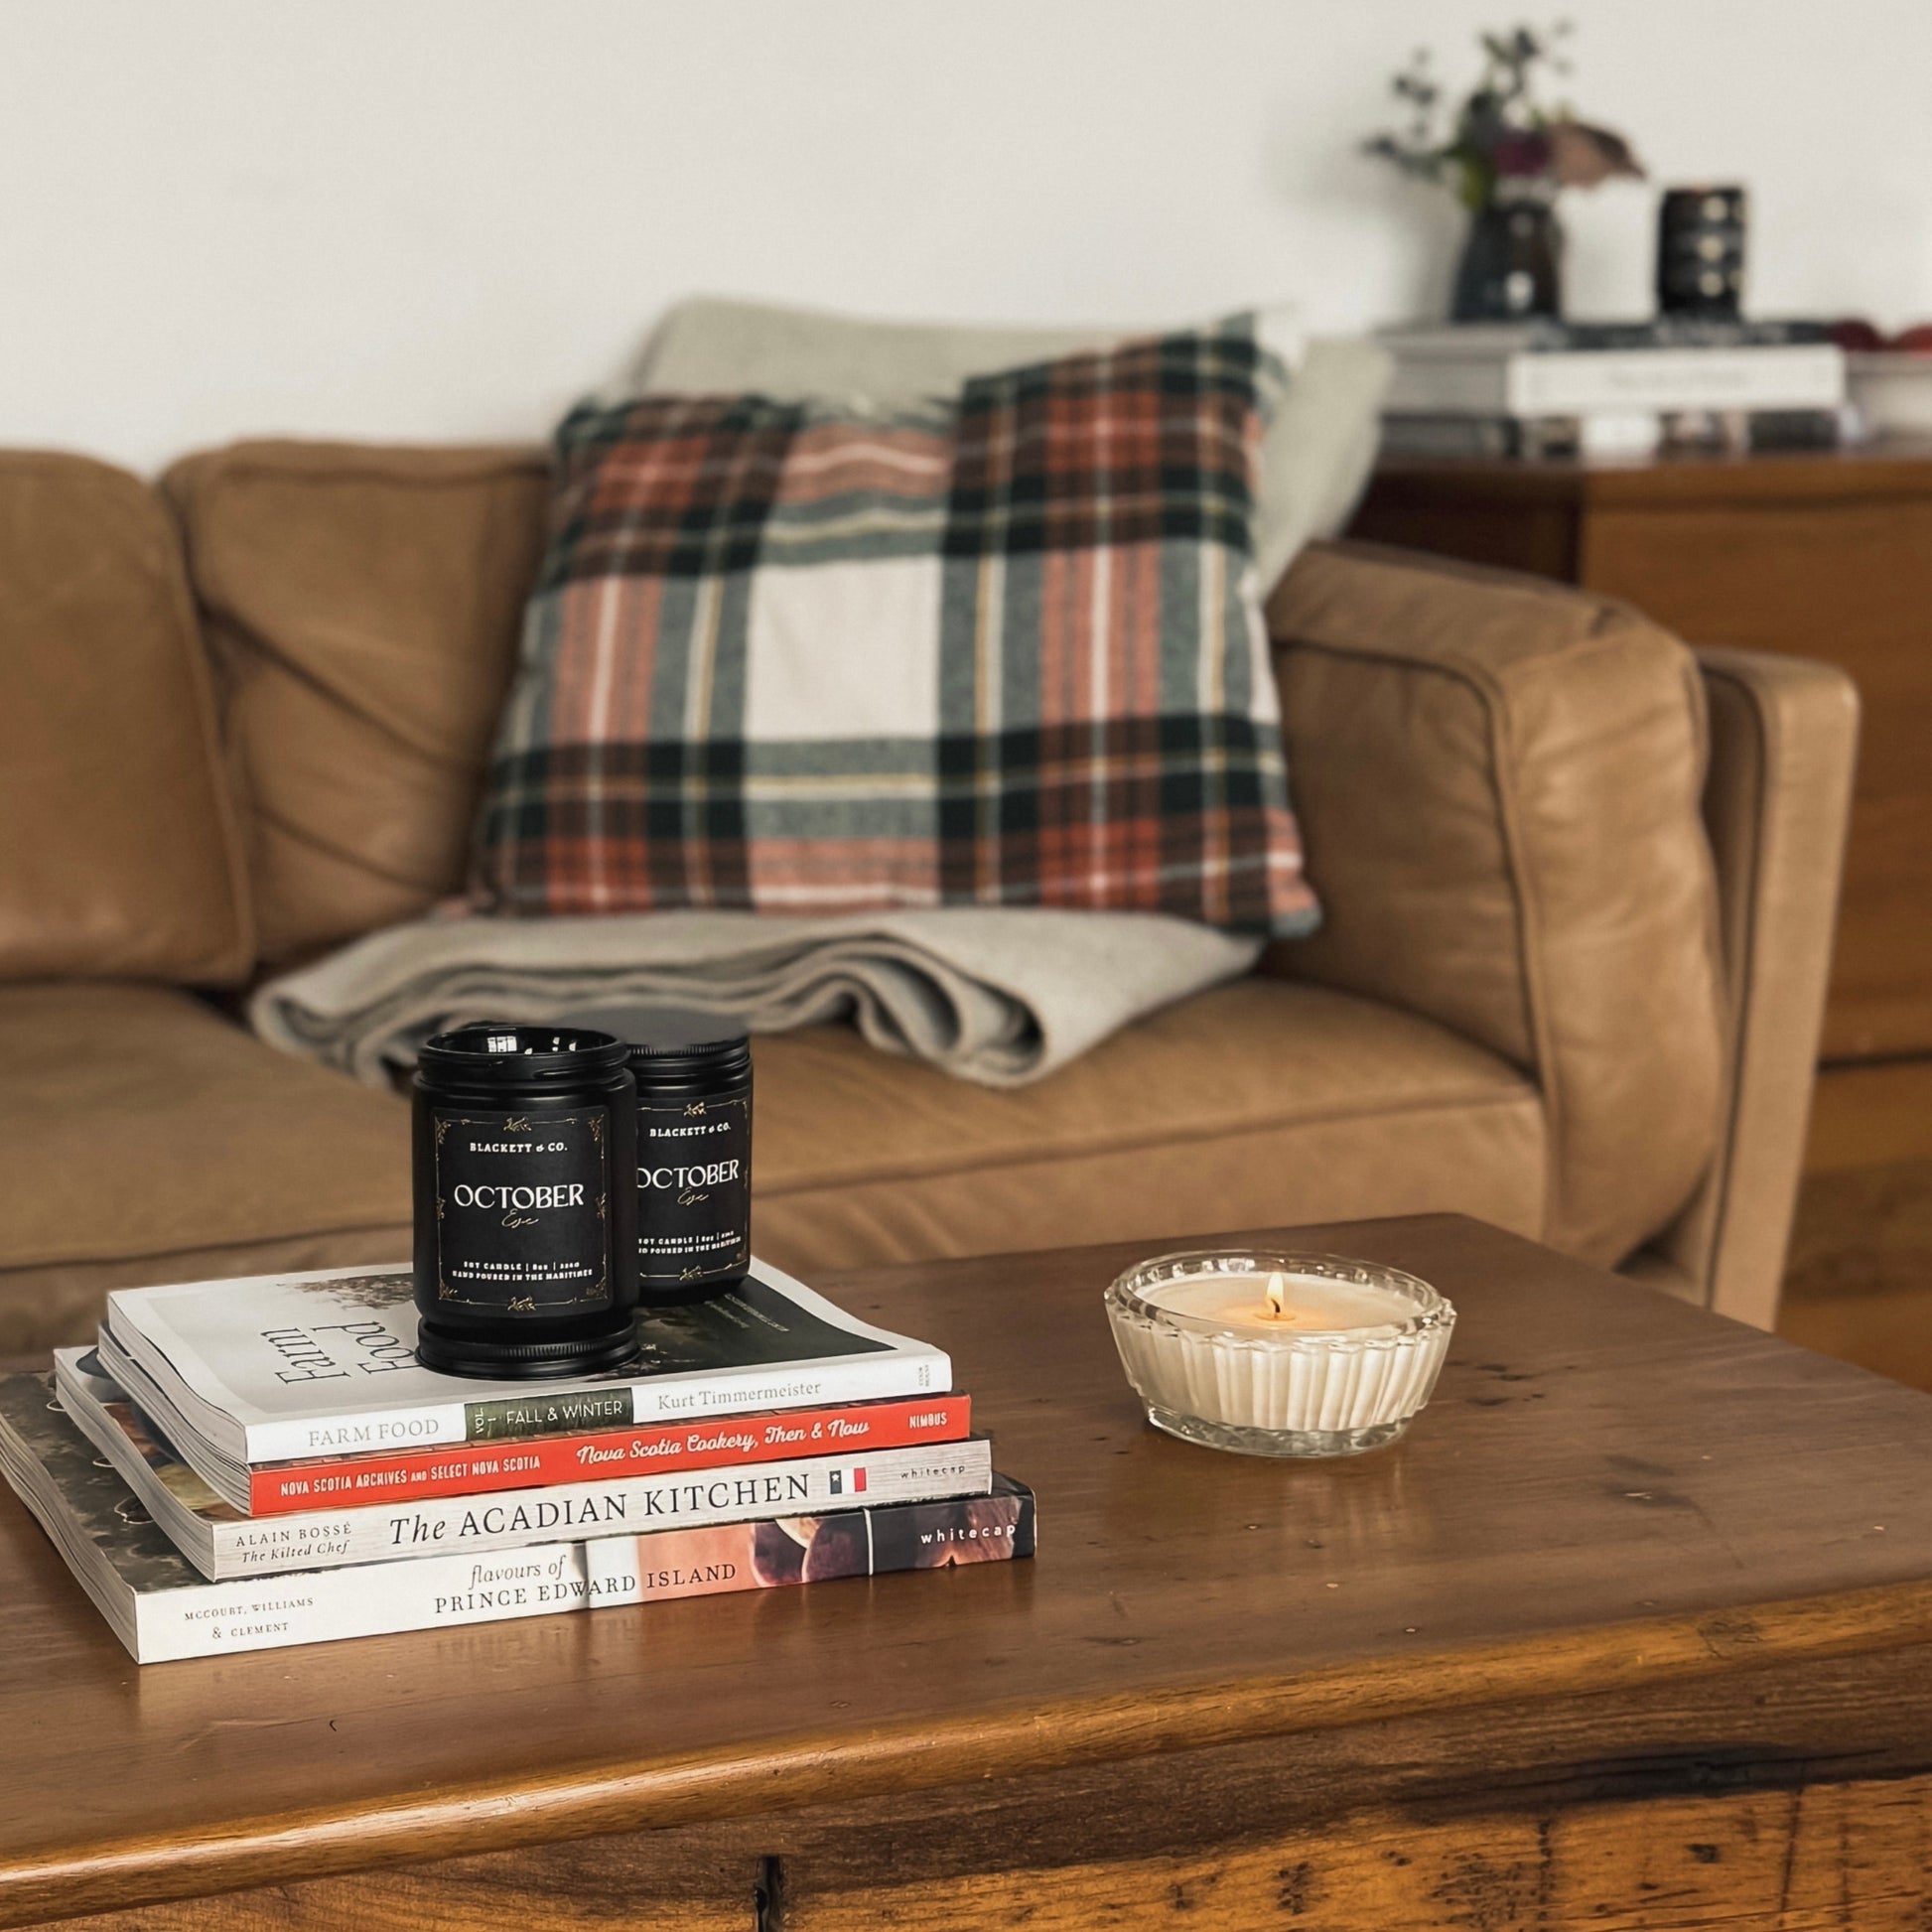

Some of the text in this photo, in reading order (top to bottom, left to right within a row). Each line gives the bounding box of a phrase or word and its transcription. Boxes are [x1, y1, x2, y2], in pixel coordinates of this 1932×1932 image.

[649, 1126, 706, 1138] BLACKETT
[470, 1143, 532, 1153] BLACKETT
[548, 1142, 568, 1152] CO.
[636, 1159, 740, 1189] OCTOBER
[454, 1183, 585, 1209] OCTOBER
[476, 1272, 510, 1281] POURED
[260, 1327, 351, 1385] Farm
[310, 1320, 423, 1374] Food
[658, 1382, 822, 1411] Kurt Timmermeister
[506, 1400, 623, 1426] FALL & WINTER
[909, 1412, 947, 1429] NIMBUS
[309, 1418, 439, 1448] FARM FOOD
[576, 1419, 870, 1464] Nova Scotia Cookery, Then & Now
[281, 1481, 309, 1497] NOVA
[314, 1477, 352, 1492] SCOTIA
[355, 1469, 407, 1487] ARCHIVES
[431, 1463, 468, 1480] SELECT
[472, 1459, 499, 1476] NOVA
[503, 1455, 541, 1471] SCOTIA
[900, 1464, 966, 1479] whitecap
[390, 1473, 811, 1545] The ACADIAN KITCHEN
[236, 1530, 291, 1548] ALAIN
[921, 1524, 1017, 1545] whitecap
[242, 1540, 351, 1564] The Kilted Chef
[469, 1555, 567, 1590] flavours of
[435, 1563, 737, 1614] PRINCE EDWARD ISLAND
[185, 1596, 315, 1621] MCCOURT, WILLIAMS
[211, 1622, 289, 1639] & CLEMENT
